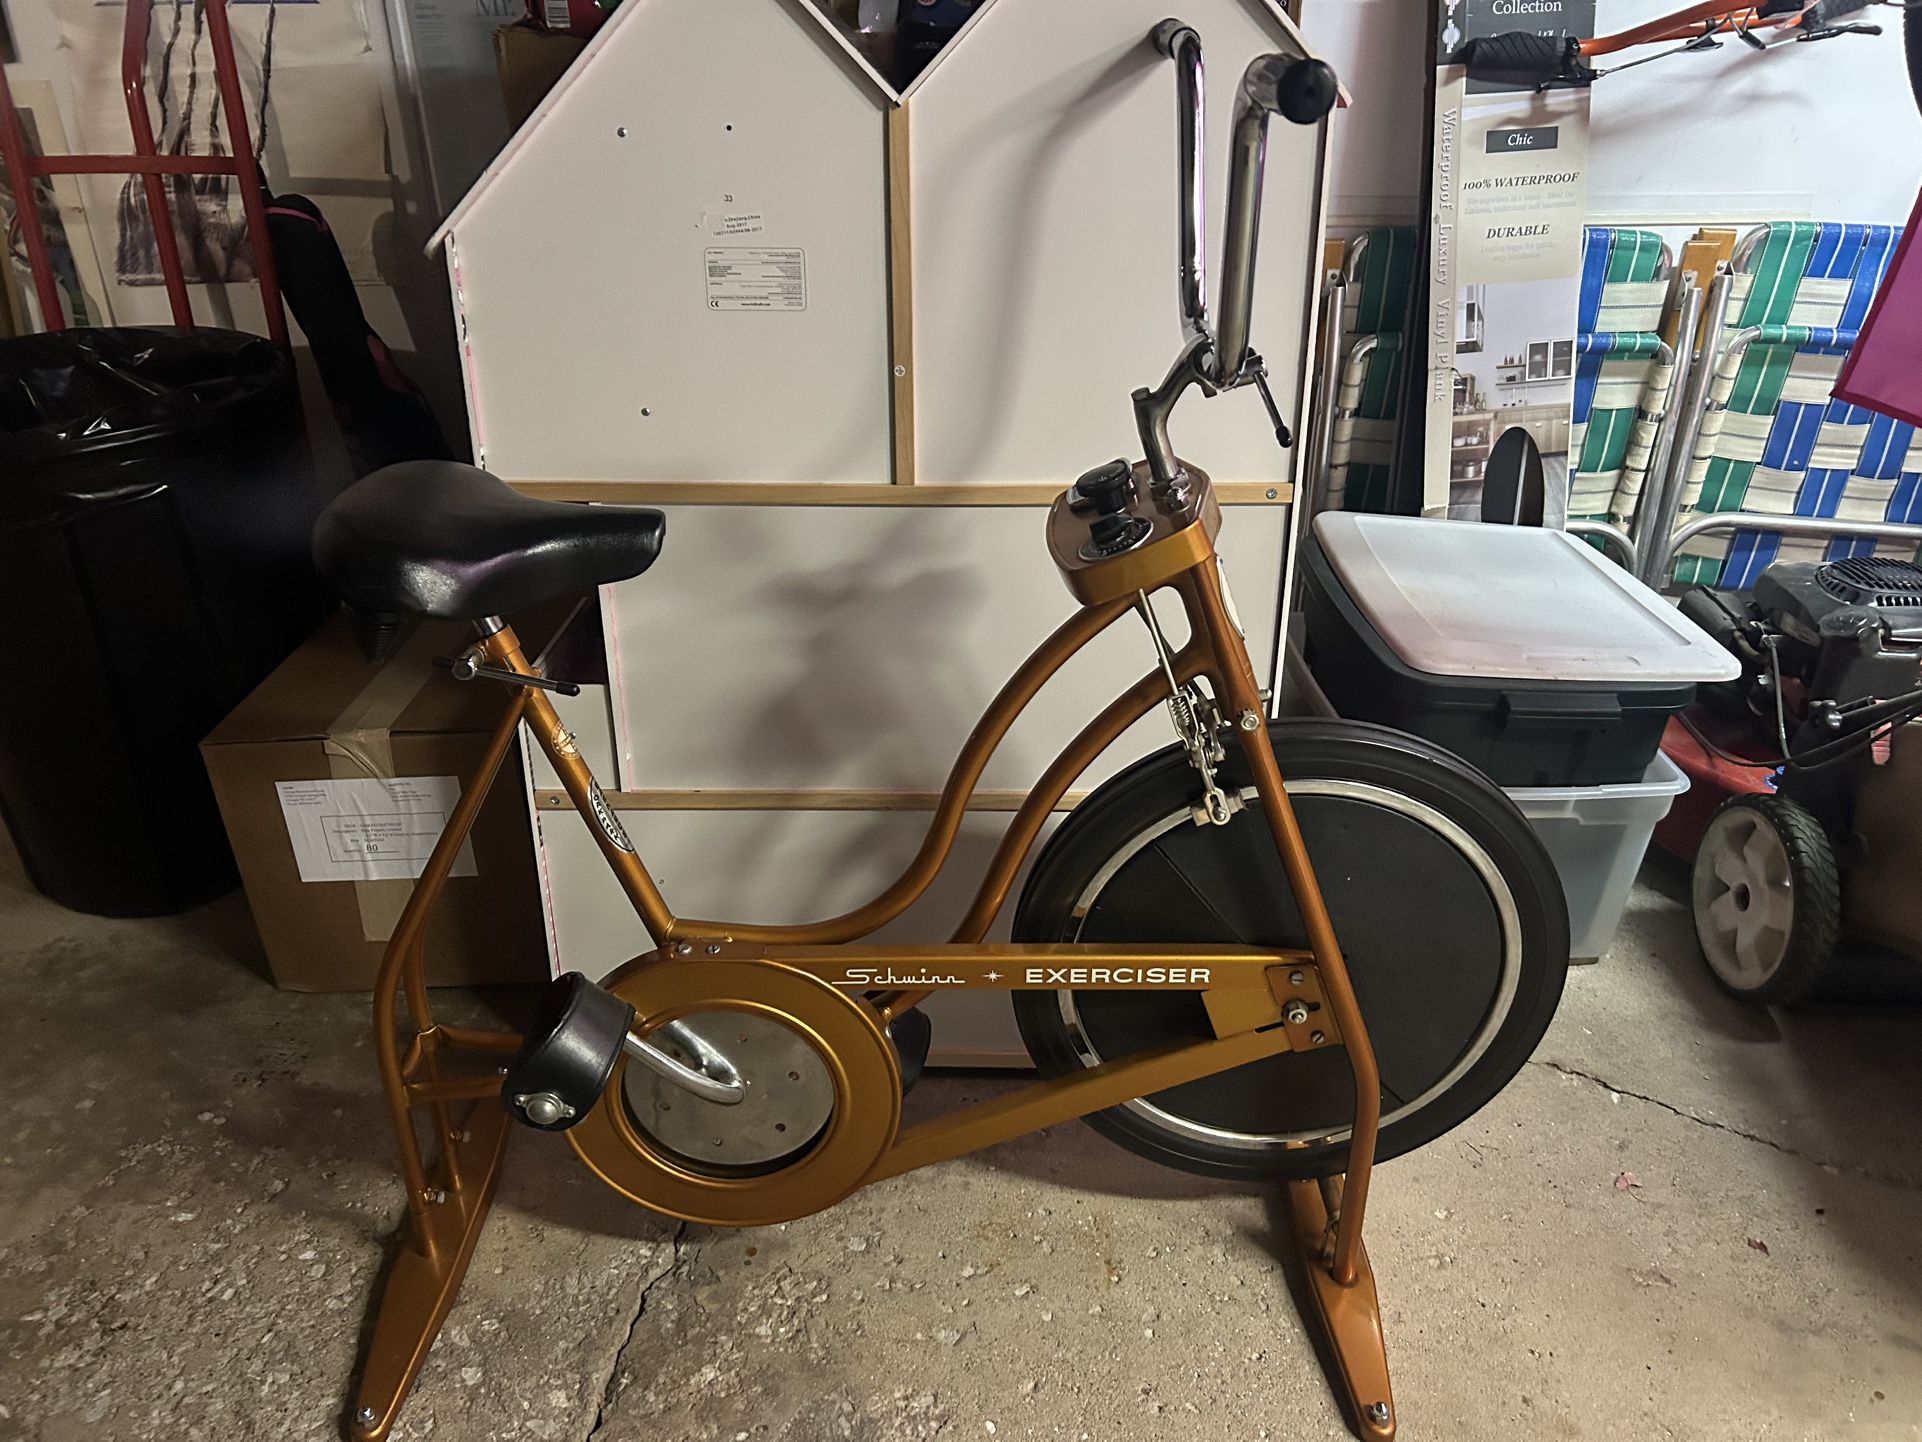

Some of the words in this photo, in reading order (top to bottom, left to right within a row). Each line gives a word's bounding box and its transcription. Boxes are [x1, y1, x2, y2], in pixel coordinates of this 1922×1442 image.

[1492, 0, 1562, 15] Collection
[1507, 133, 1534, 147] Chic
[1438, 108, 1456, 211] Waterproof
[1463, 178, 1492, 190] 100%
[1495, 171, 1580, 188] WATERPROOF
[1486, 223, 1551, 239] DURABLE
[1434, 223, 1453, 286] Luxury
[1434, 298, 1450, 346] Vinyl
[366, 844, 378, 852] 80
[832, 968, 966, 984] Schwinn
[1025, 968, 1211, 984] EXERCISER
